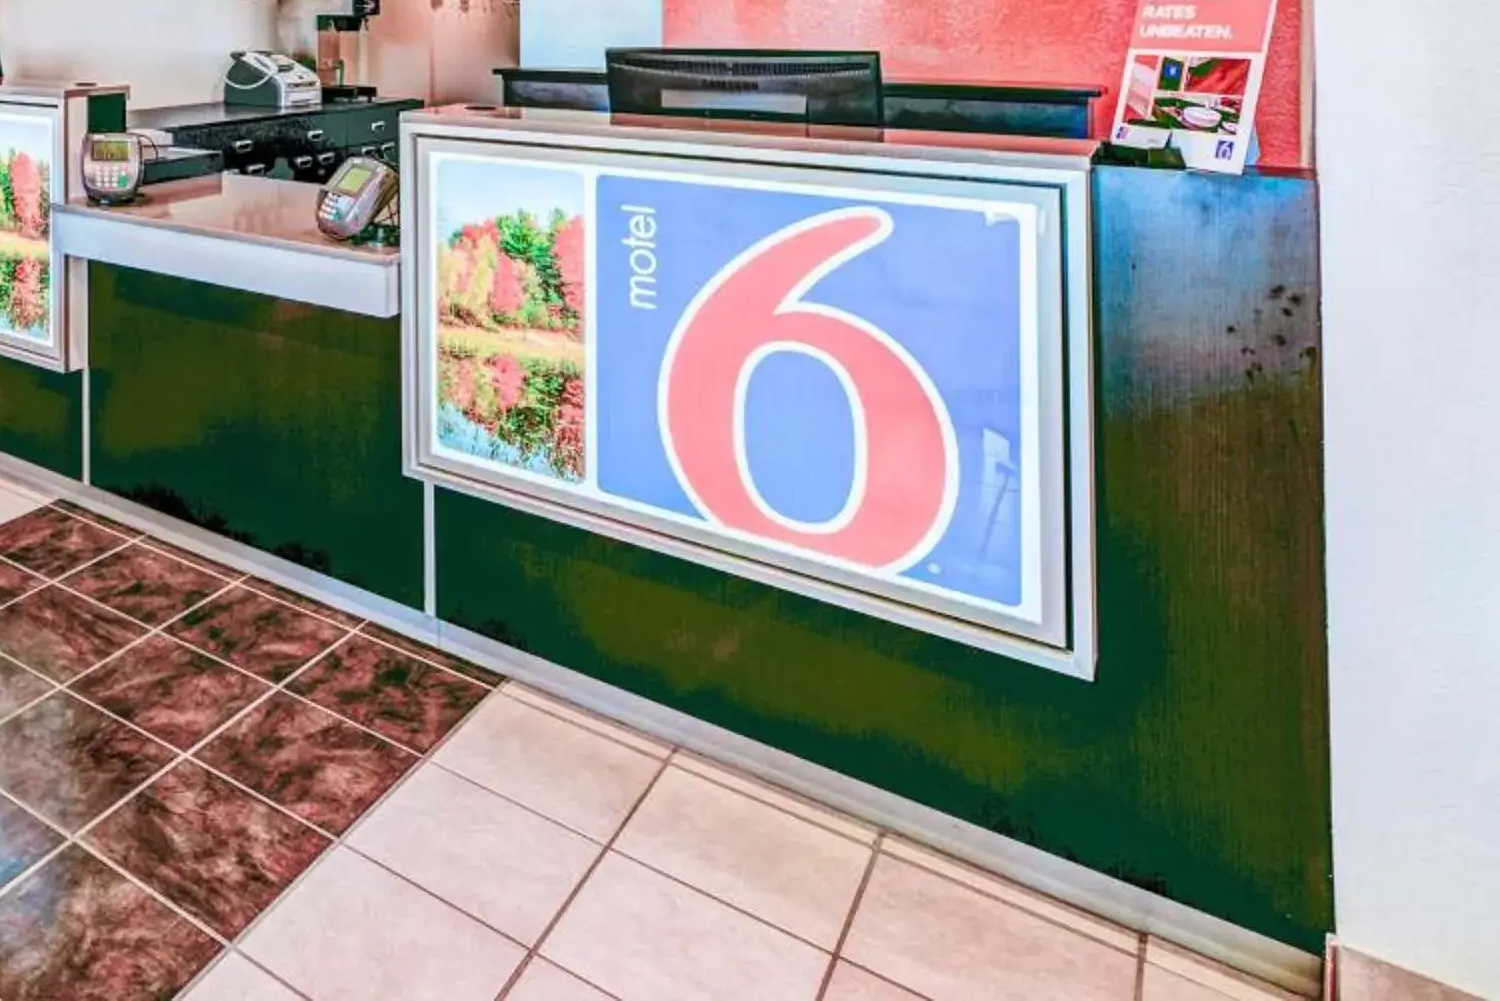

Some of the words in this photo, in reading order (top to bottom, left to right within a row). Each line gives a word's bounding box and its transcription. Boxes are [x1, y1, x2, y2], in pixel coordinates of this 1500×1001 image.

[1142, 4, 1198, 19] RATES
[620, 204, 657, 310] motel
[657, 205, 960, 574] 6
